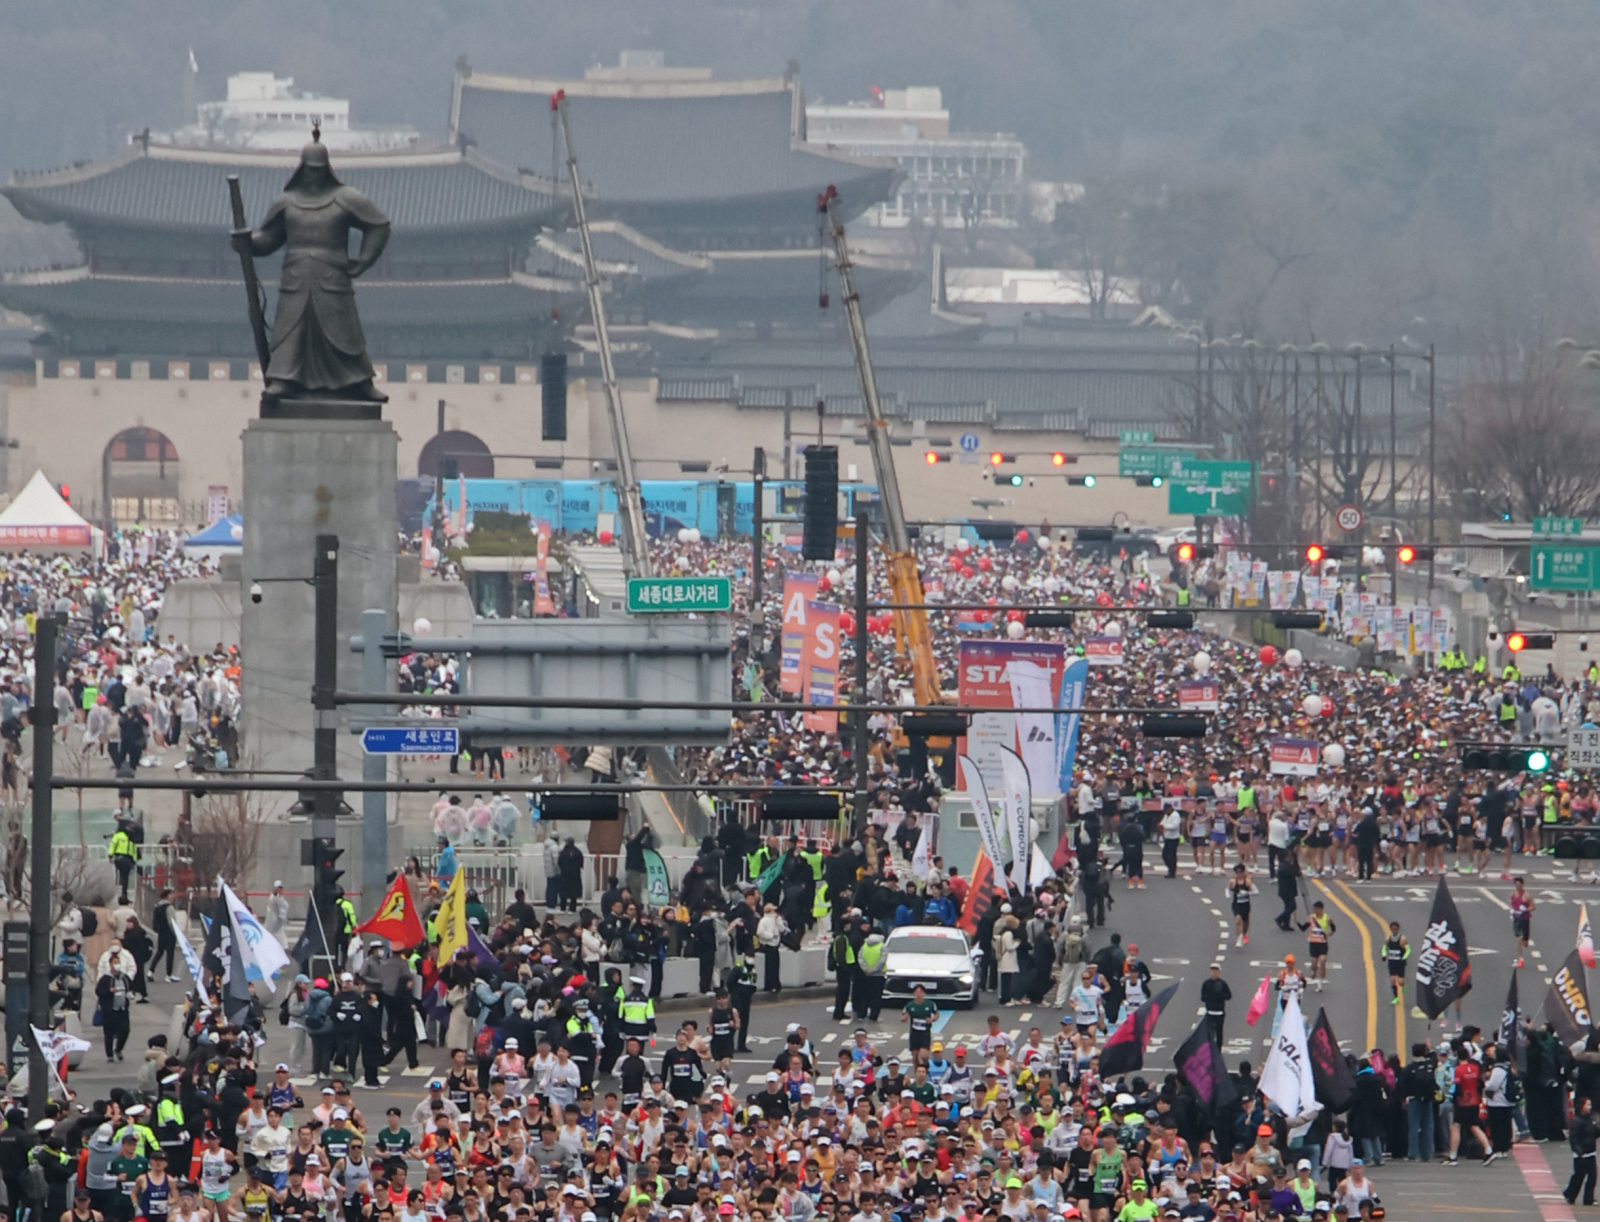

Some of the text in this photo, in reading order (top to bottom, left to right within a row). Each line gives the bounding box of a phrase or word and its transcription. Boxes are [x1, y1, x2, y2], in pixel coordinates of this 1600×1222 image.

[1342, 512, 1358, 525] 50
[638, 584, 719, 604] 세종대로사거리
[784, 592, 807, 626] A
[814, 622, 835, 660] S
[1202, 686, 1213, 700] B
[1299, 748, 1313, 763] A
